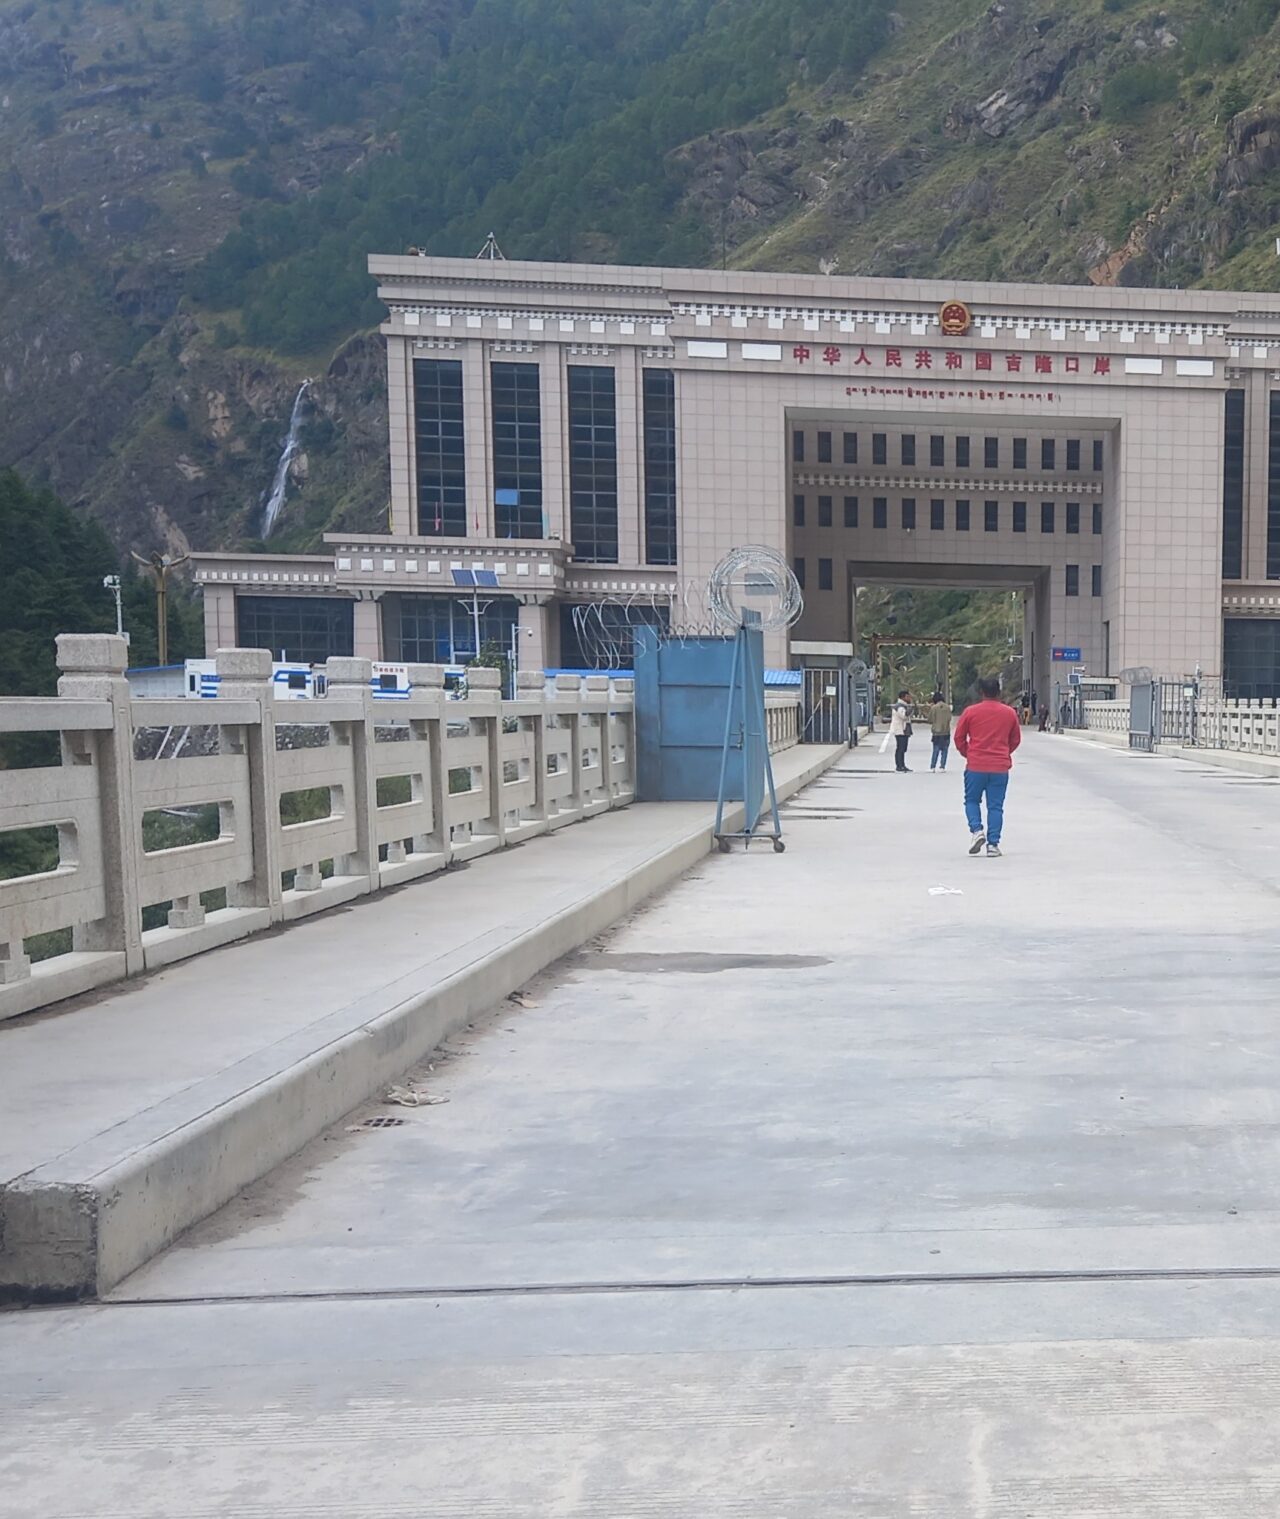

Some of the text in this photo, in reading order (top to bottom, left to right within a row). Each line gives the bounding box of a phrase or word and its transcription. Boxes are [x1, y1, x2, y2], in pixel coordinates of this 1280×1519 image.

[793, 345, 1111, 375] 中华人民共和国吉隆口岸
